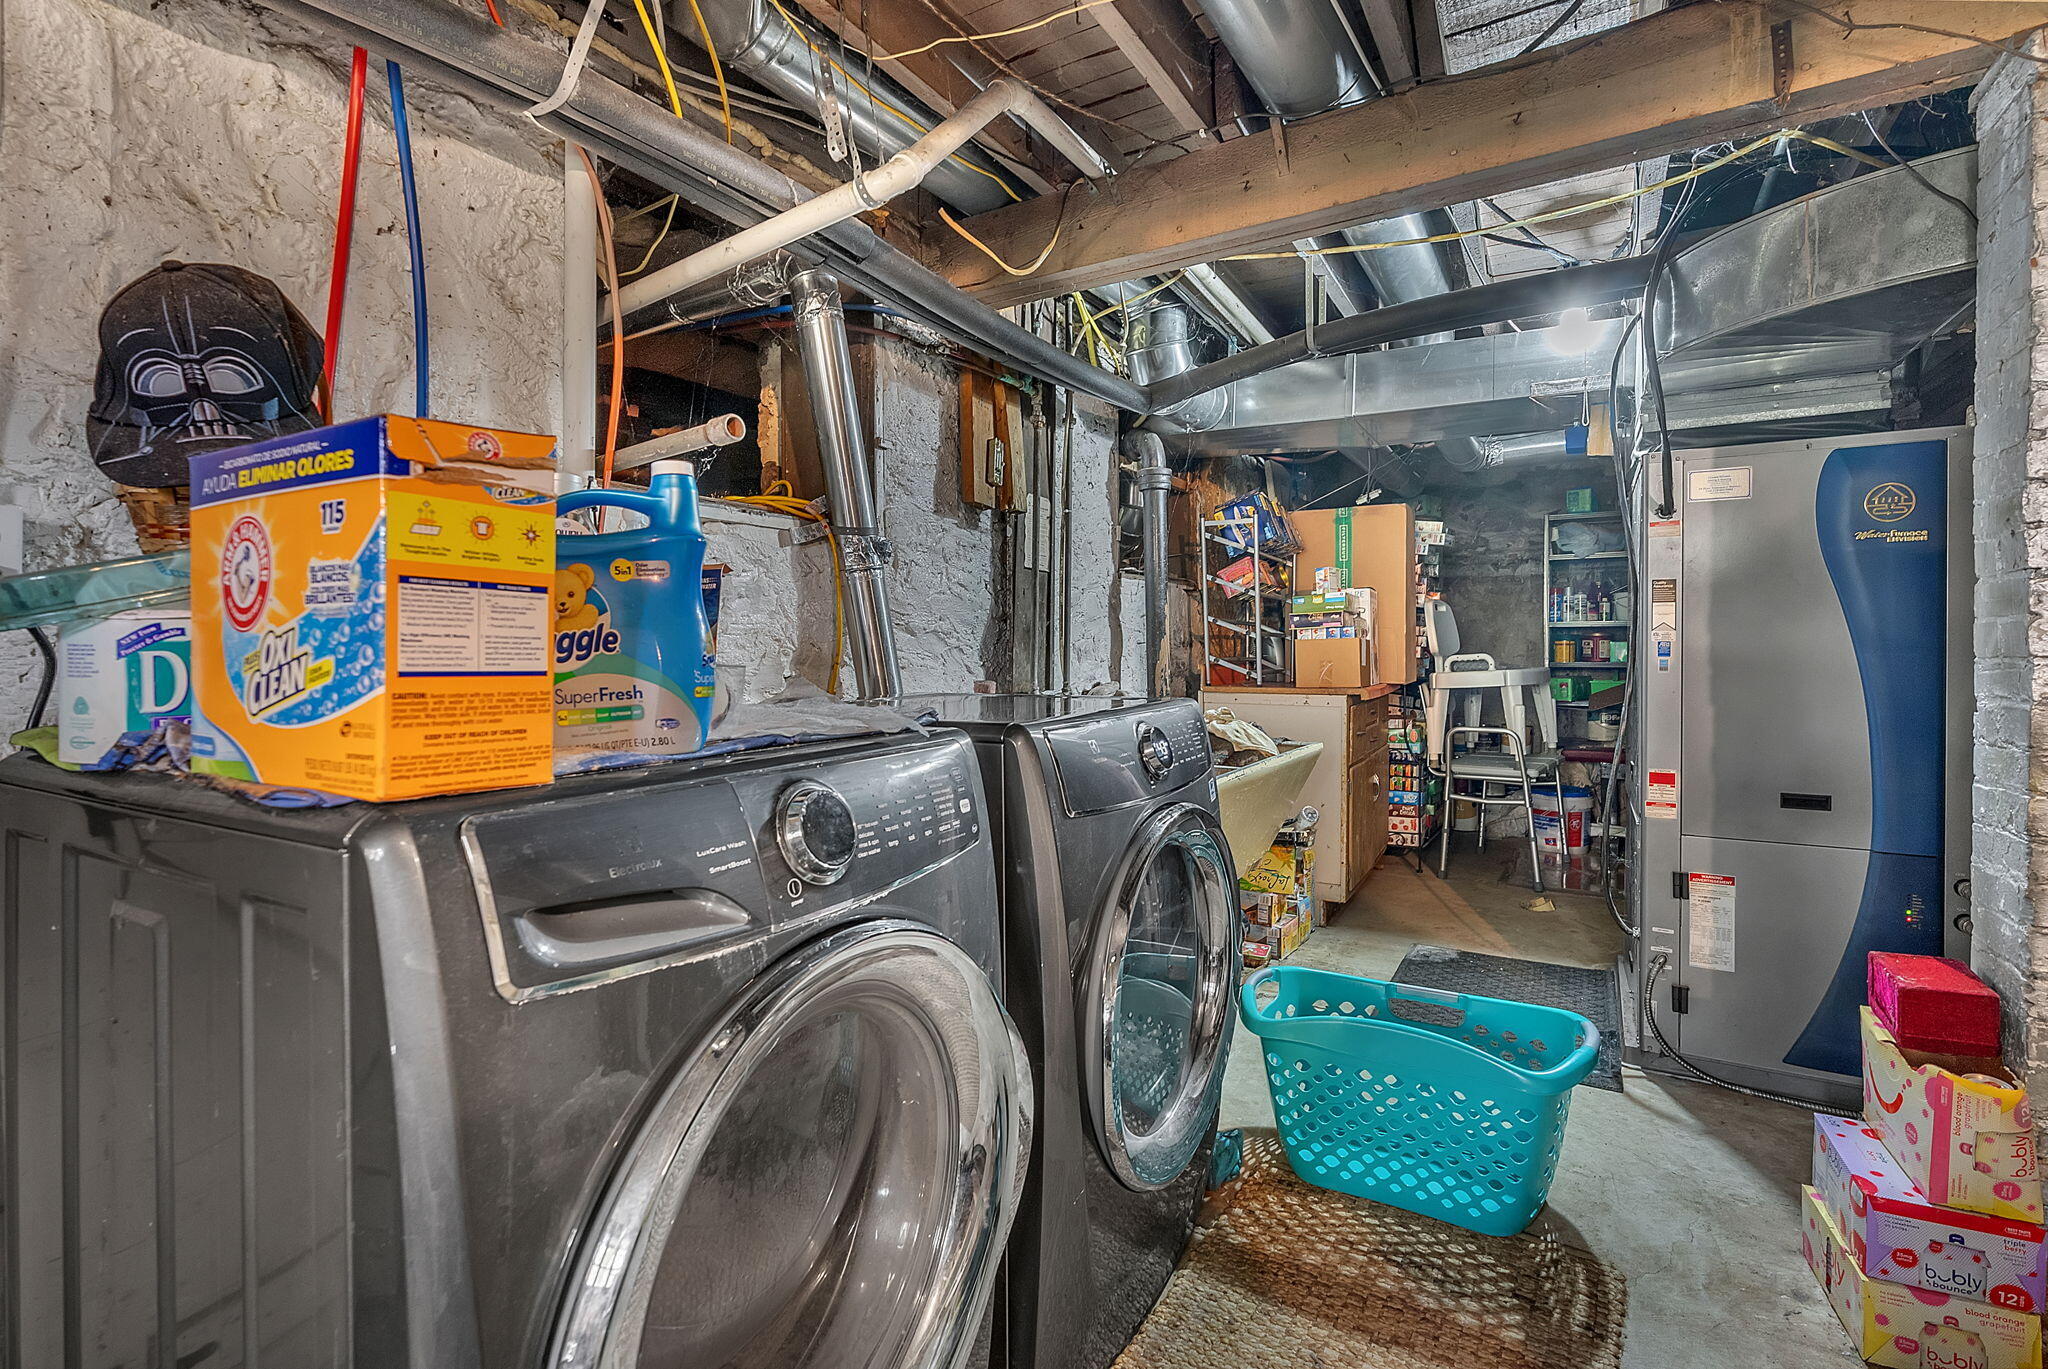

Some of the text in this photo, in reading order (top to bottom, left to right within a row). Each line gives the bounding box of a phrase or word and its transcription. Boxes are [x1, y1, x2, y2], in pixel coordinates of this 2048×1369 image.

[202, 448, 355, 496] AYUDA ELIMINAR OLORES
[321, 500, 344, 525] 115
[615, 566, 632, 576] 5in1
[259, 627, 295, 673] OXI
[555, 623, 619, 664] ggle
[247, 652, 309, 716] CLEAN
[555, 685, 643, 707] SuperFresh
[651, 737, 669, 747] 2.80
[696, 840, 748, 858] LuxCare Wash
[608, 858, 663, 879] Electrolux
[708, 857, 752, 874] SmartBoost
[1953, 1092, 1965, 1136] blood orange
[2010, 1135, 2029, 1178] bubly
[2003, 1238, 2026, 1248] triple
[2004, 1245, 2027, 1255] berry
[1925, 1263, 1982, 1293] bubly
[1933, 1281, 1973, 1295] bounce
[1999, 1290, 2018, 1306] 12
[1965, 1308, 2025, 1327] blood orange
[1979, 1319, 2026, 1333] grapefruit
[1927, 1346, 1984, 1369] bubly
